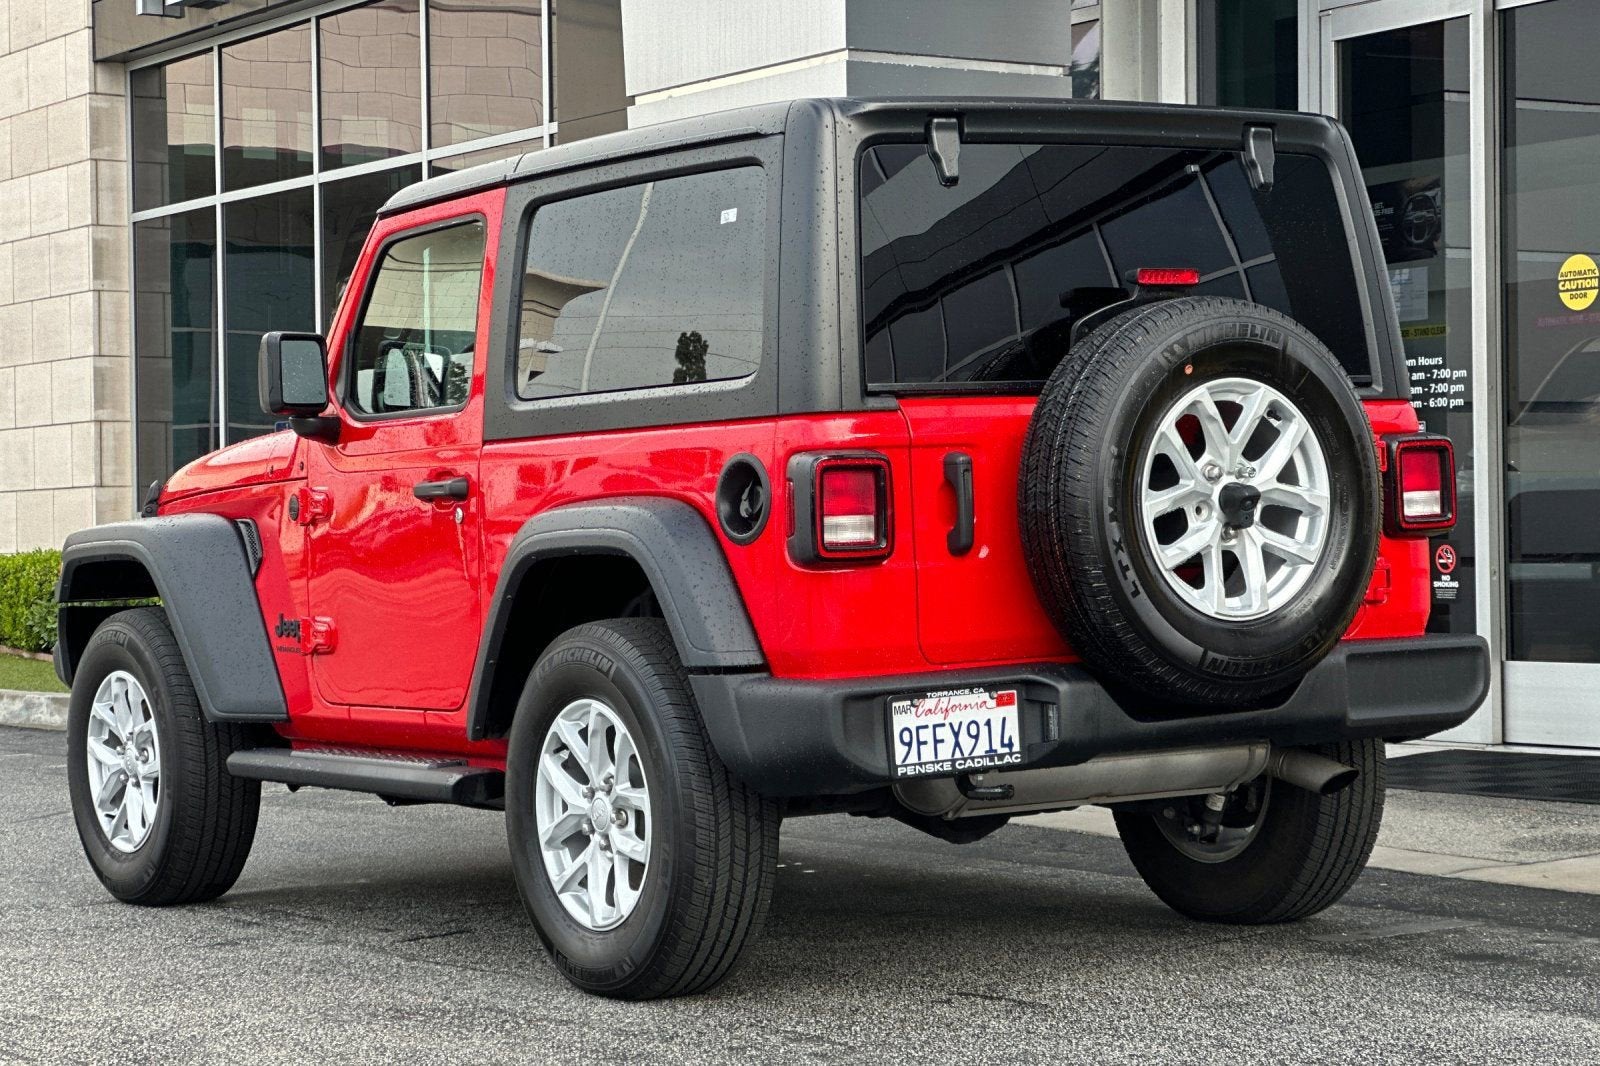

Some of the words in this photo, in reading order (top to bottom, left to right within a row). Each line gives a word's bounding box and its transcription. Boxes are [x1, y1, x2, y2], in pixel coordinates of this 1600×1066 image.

[1559, 268, 1597, 278] AUTOMATIC
[1558, 278, 1599, 291] CAUTION
[1569, 292, 1588, 300] DOOR
[1187, 322, 1284, 350] MICHELIN
[1414, 327, 1429, 337] STAND
[1417, 356, 1443, 366] Hours
[1411, 372, 1425, 380] am
[1432, 368, 1451, 379] 7:00
[1452, 369, 1467, 380] pm
[1410, 386, 1423, 394] am
[1429, 382, 1448, 394] 7:00
[1450, 384, 1465, 395] pm
[1429, 397, 1448, 408] 6:00
[1449, 398, 1464, 409] pm
[1111, 537, 1141, 599] LTX
[1433, 580, 1459, 588] SMOKING
[1441, 574, 1451, 582] NO
[552, 648, 613, 672] MICHELIN
[926, 689, 971, 699] TORRANCE,
[893, 704, 912, 716] MAR
[915, 698, 990, 721] California
[899, 716, 1015, 764] 9FFX914
[897, 762, 952, 777] PENSKE
[955, 753, 1022, 770] CADILLAC
